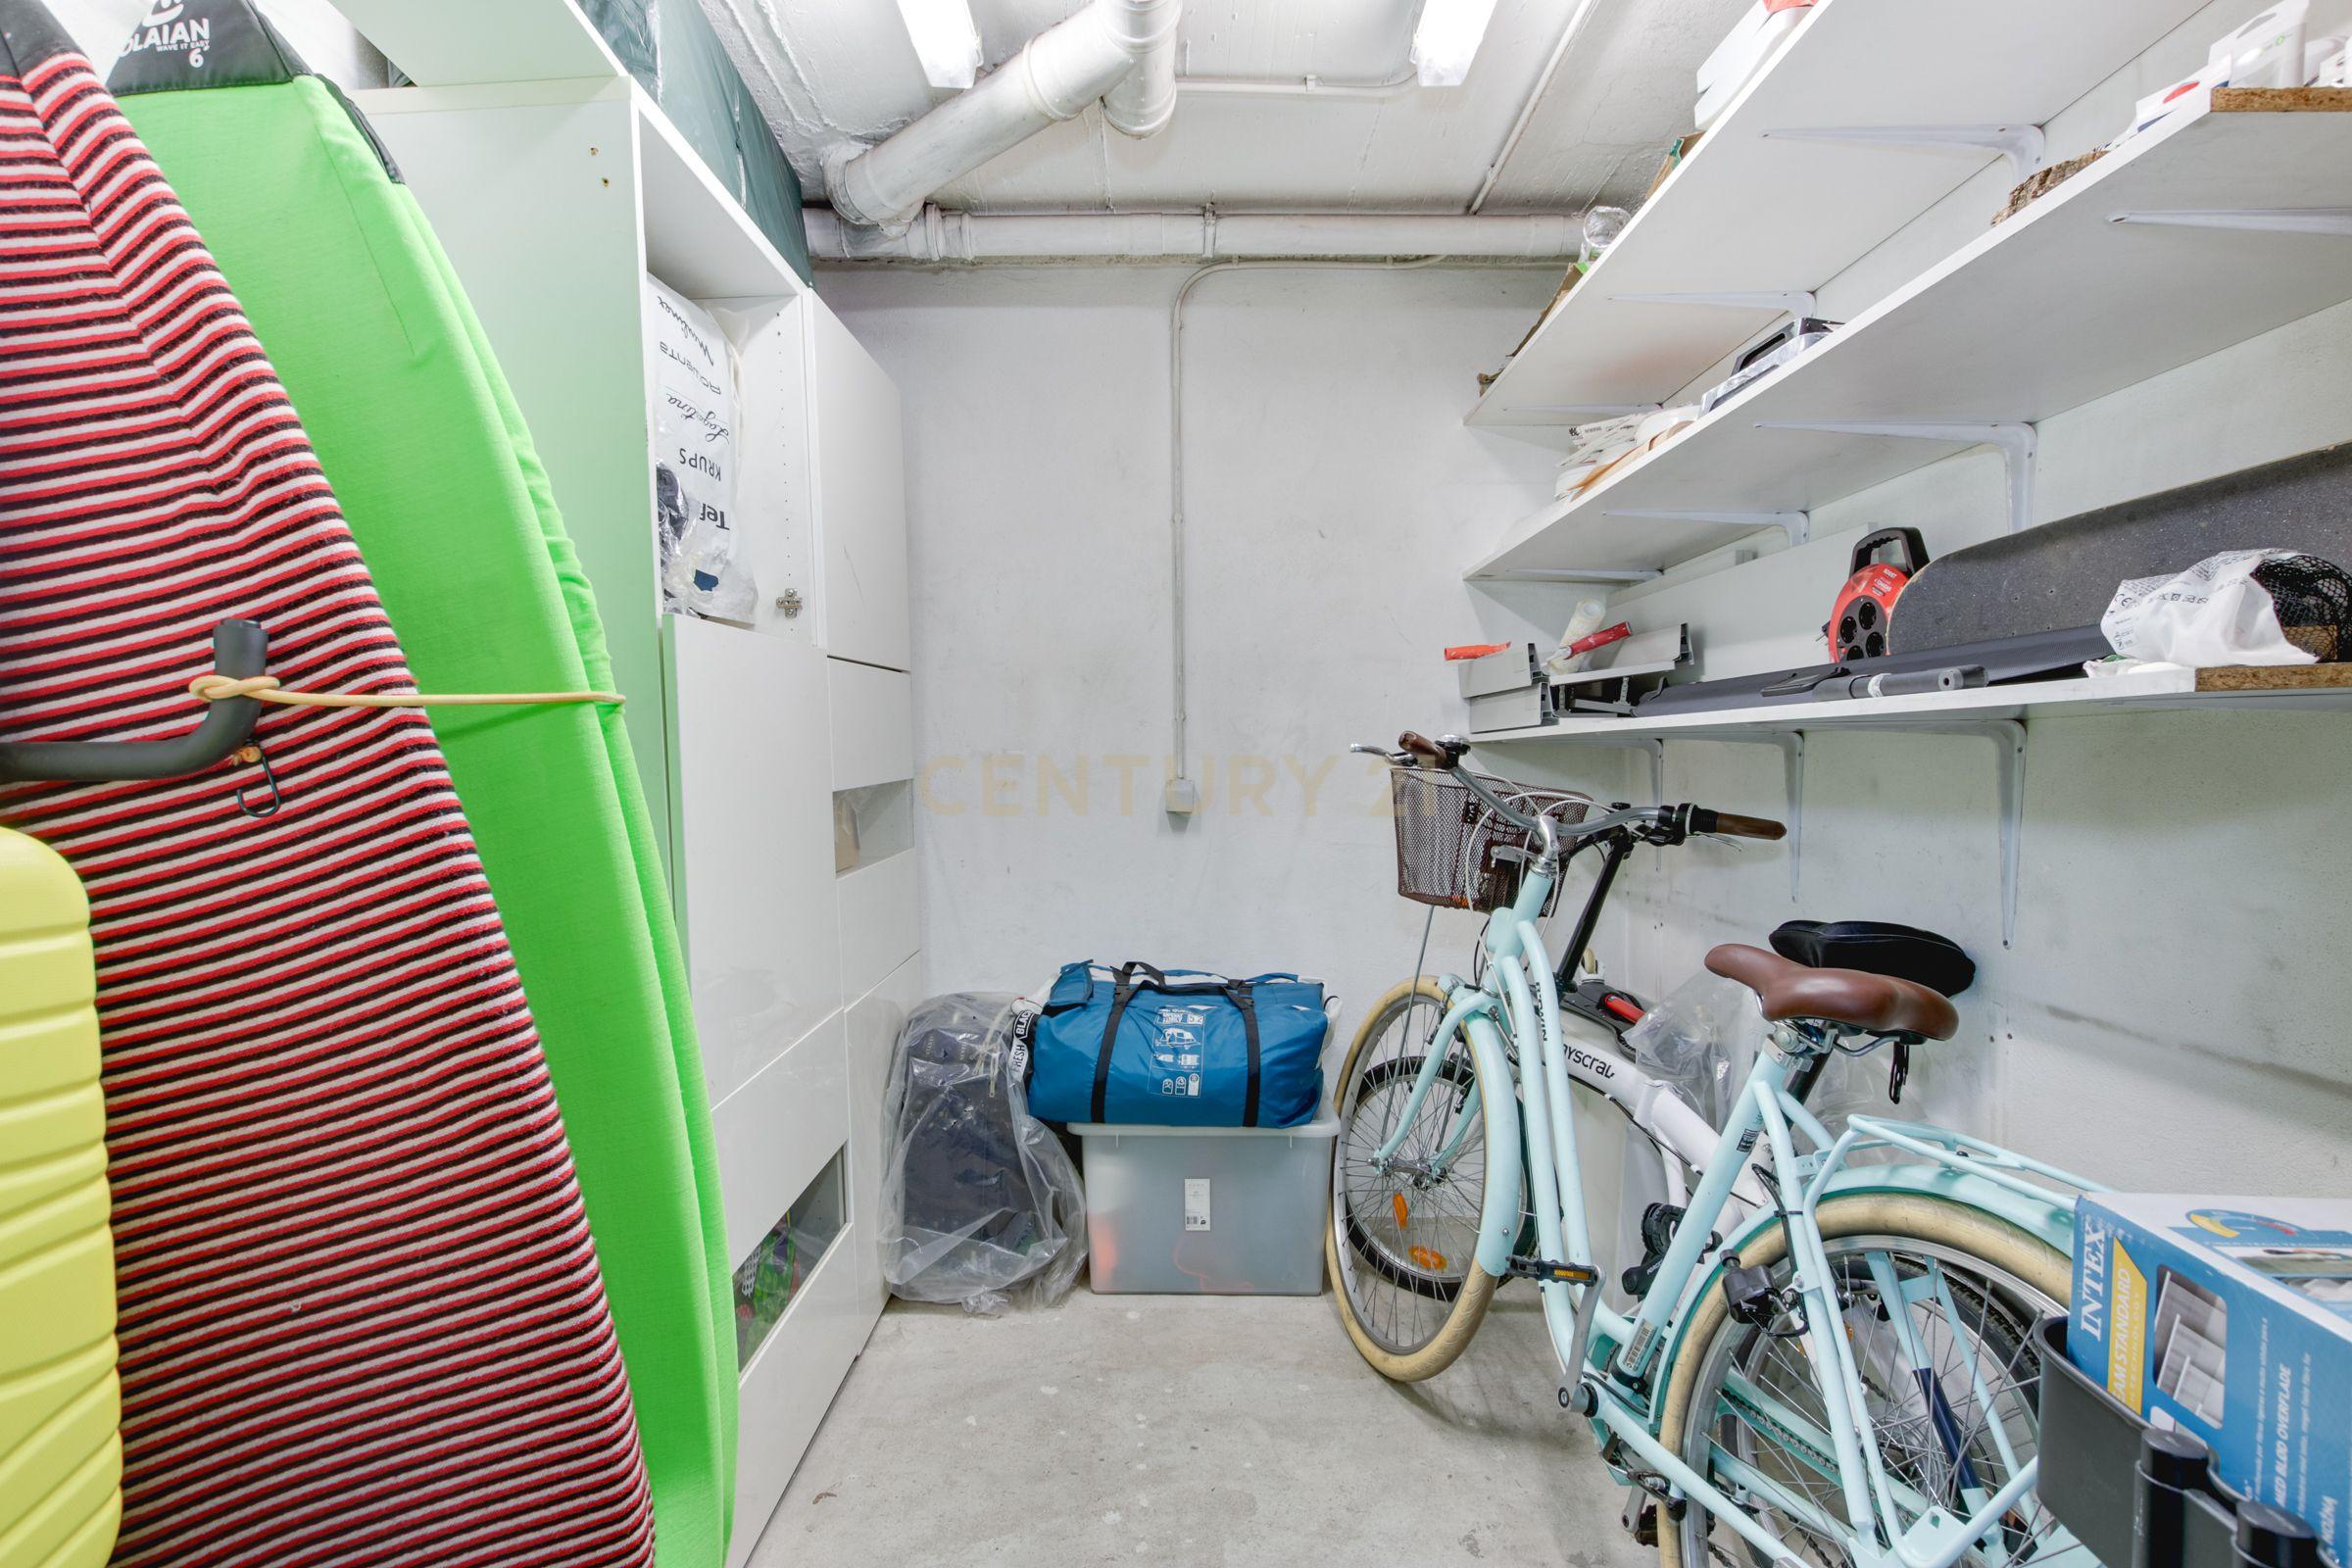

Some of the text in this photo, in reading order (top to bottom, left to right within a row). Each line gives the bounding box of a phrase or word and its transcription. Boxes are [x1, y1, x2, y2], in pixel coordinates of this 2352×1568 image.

[157, 43, 178, 52] WAVE
[679, 448, 721, 481] KRUPS
[699, 503, 730, 530] Tef
[2081, 1222, 2106, 1342] INTEX
[2112, 1268, 2132, 1404] EAM STANDARD
[2277, 1363, 2291, 1441] OVERFLADE
